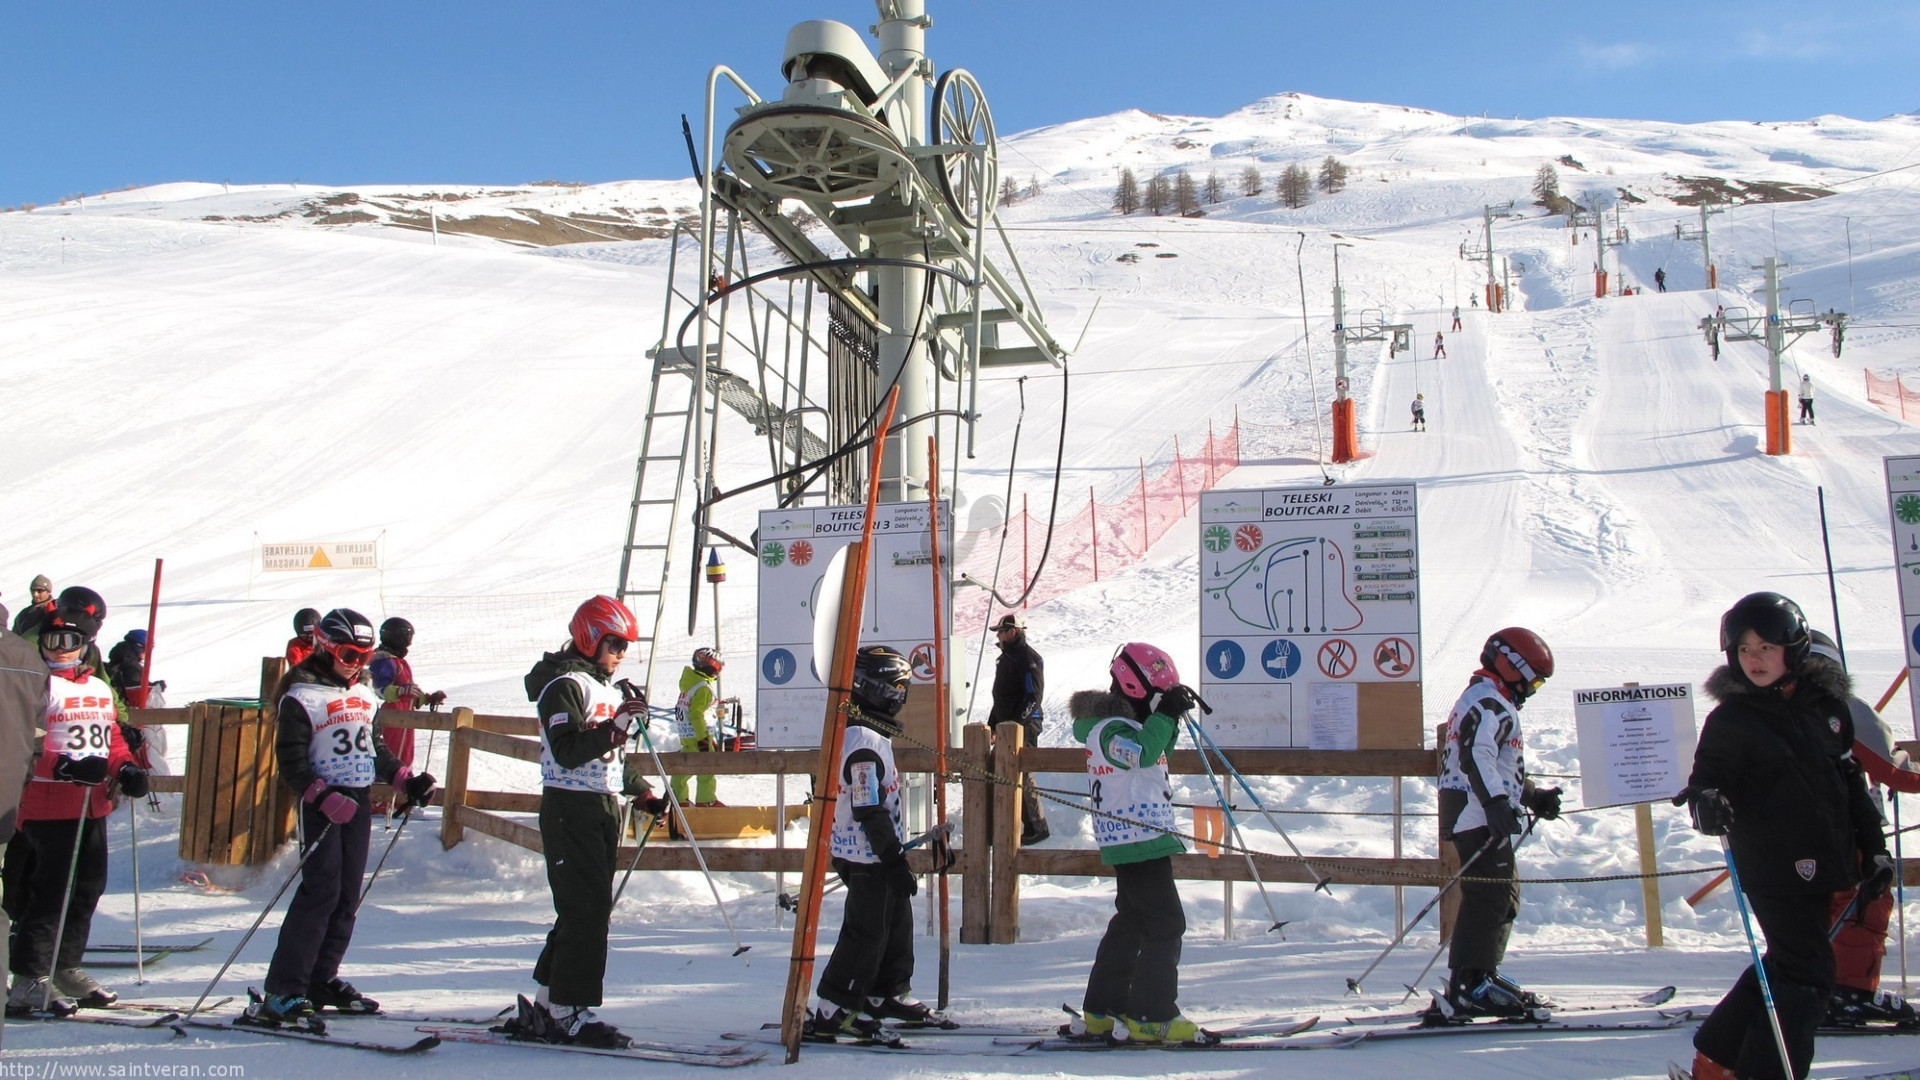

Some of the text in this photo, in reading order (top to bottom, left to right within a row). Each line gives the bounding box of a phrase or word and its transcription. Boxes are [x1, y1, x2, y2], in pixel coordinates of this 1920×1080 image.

[1282, 493, 1332, 504] TELESKI
[1265, 504, 1350, 517] BOUTICARI 2
[882, 520, 890, 530] 3
[1577, 686, 1687, 703] INFORMATIONS
[64, 696, 110, 710] ESF
[326, 696, 372, 718] ESF
[66, 724, 111, 750] 380
